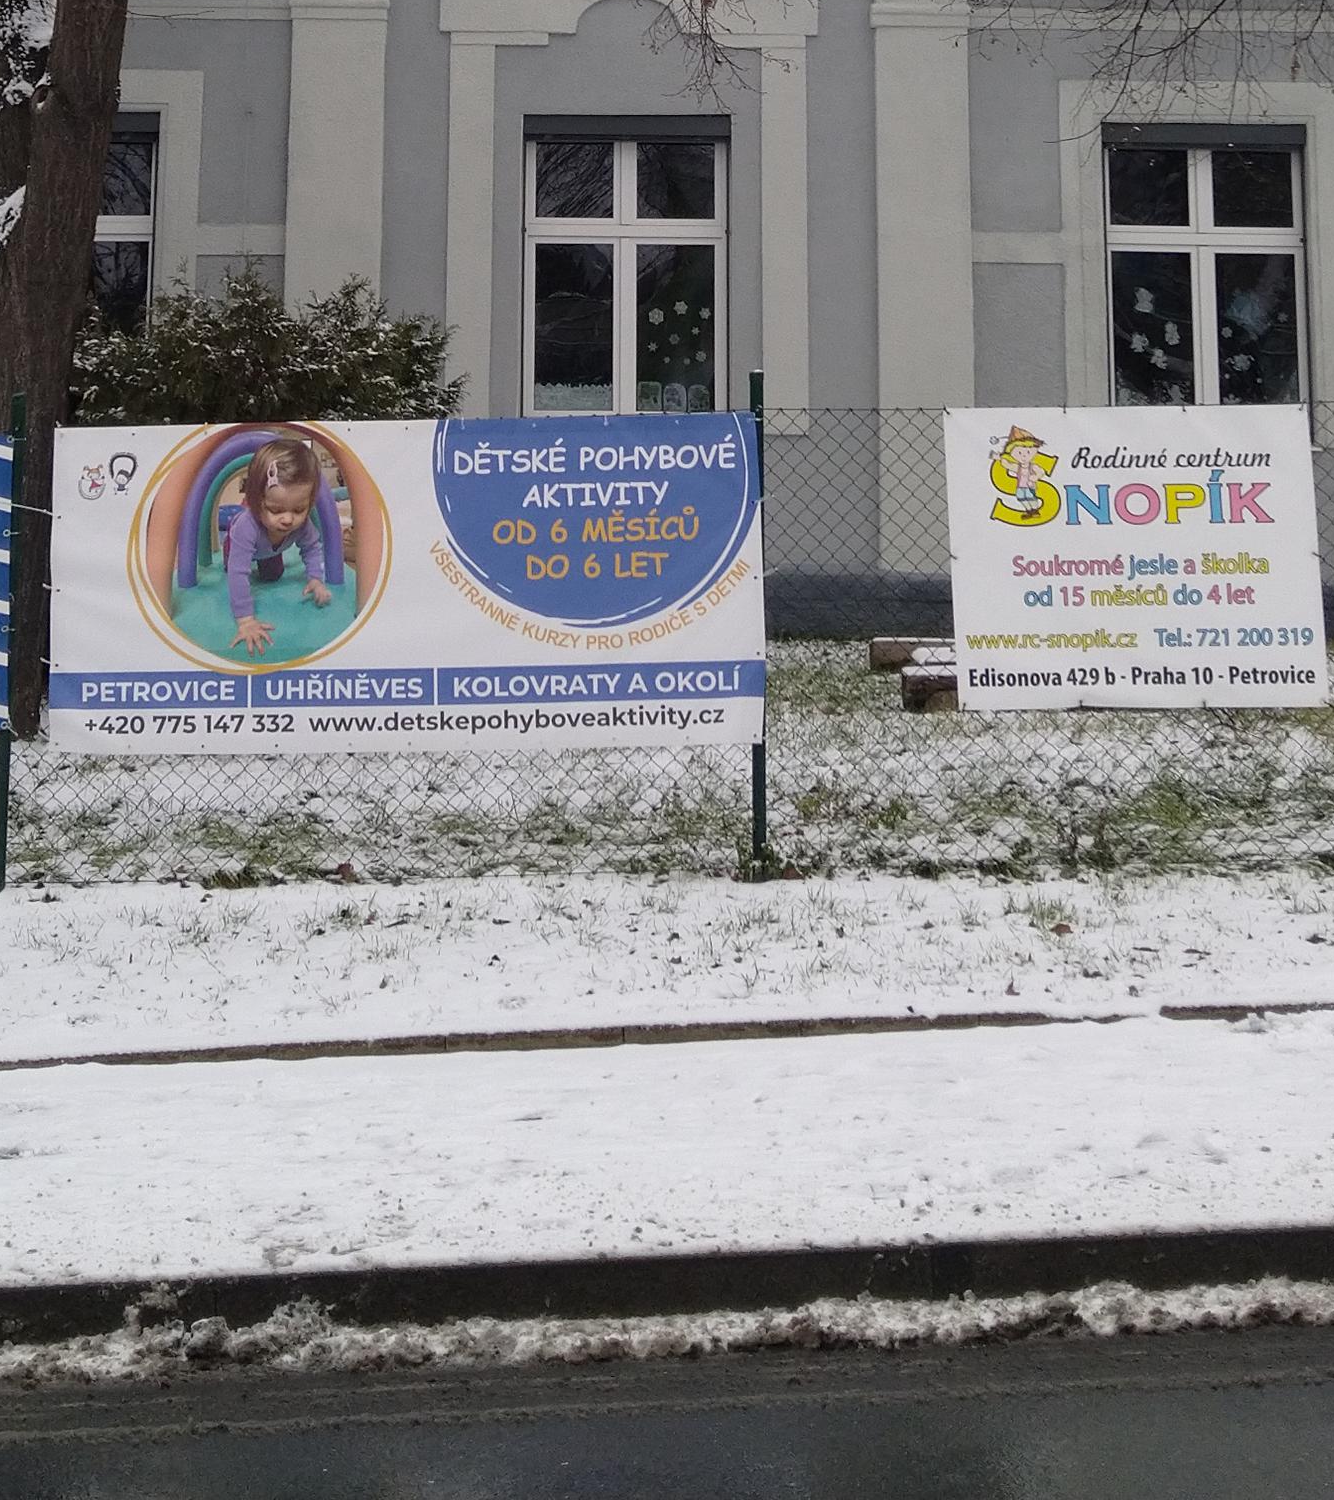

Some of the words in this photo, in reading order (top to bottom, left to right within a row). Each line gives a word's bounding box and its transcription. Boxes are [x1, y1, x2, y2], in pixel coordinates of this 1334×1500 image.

[454, 438, 566, 475] DĚTSKÉ
[579, 434, 736, 471] POHYBOVÉ
[1071, 447, 1167, 470] Rodinné
[1174, 451, 1271, 468] centrum
[522, 481, 668, 508] AKTIVITY
[989, 450, 1275, 527] SNOPÍK
[492, 519, 536, 545] OD
[551, 518, 568, 543] 6
[582, 506, 699, 542] MĚSÍCŮ
[526, 555, 569, 580] DO
[583, 553, 601, 578] 6
[614, 551, 669, 577] LET
[1012, 555, 1124, 577] Soukromé
[1128, 554, 1179, 581] jesle
[1183, 560, 1196, 574] a
[1201, 551, 1270, 574] školka
[429, 540, 520, 631] VŠESTRANNÉ
[522, 622, 581, 649] KURZY
[586, 633, 623, 650] PRO
[628, 612, 693, 647] RODIČE
[694, 602, 708, 617] S
[706, 557, 752, 608] DĚTMI
[1023, 583, 1053, 607] od
[1060, 585, 1085, 606] 15
[1091, 583, 1167, 606] měsíců
[1173, 582, 1203, 605] do
[1207, 584, 1221, 604] 4
[1226, 583, 1255, 605] let
[967, 629, 1138, 653] www.rc-snopik.cz
[1154, 628, 1192, 648] Tel.:
[1196, 629, 1230, 647] 721
[1237, 628, 1273, 647] 200
[1278, 627, 1314, 646] 319
[265, 673, 424, 700] UHŘÍNĚVES
[453, 674, 621, 698] KOLOVRATY
[628, 673, 648, 694] A
[655, 665, 741, 693] OKOLÍ
[969, 667, 1062, 688] Edisonova
[1066, 668, 1100, 687] 429
[1104, 665, 1116, 686] b
[1131, 665, 1186, 686] Praha
[1191, 667, 1213, 685] 10
[1229, 664, 1316, 685] Petrovice
[82, 680, 236, 703] PETROVICE
[84, 715, 146, 735] +420
[153, 714, 196, 734] 775
[204, 714, 246, 733] 147
[251, 714, 296, 733] 332
[308, 706, 725, 734] www.detskepohyboveaktivity.cz
